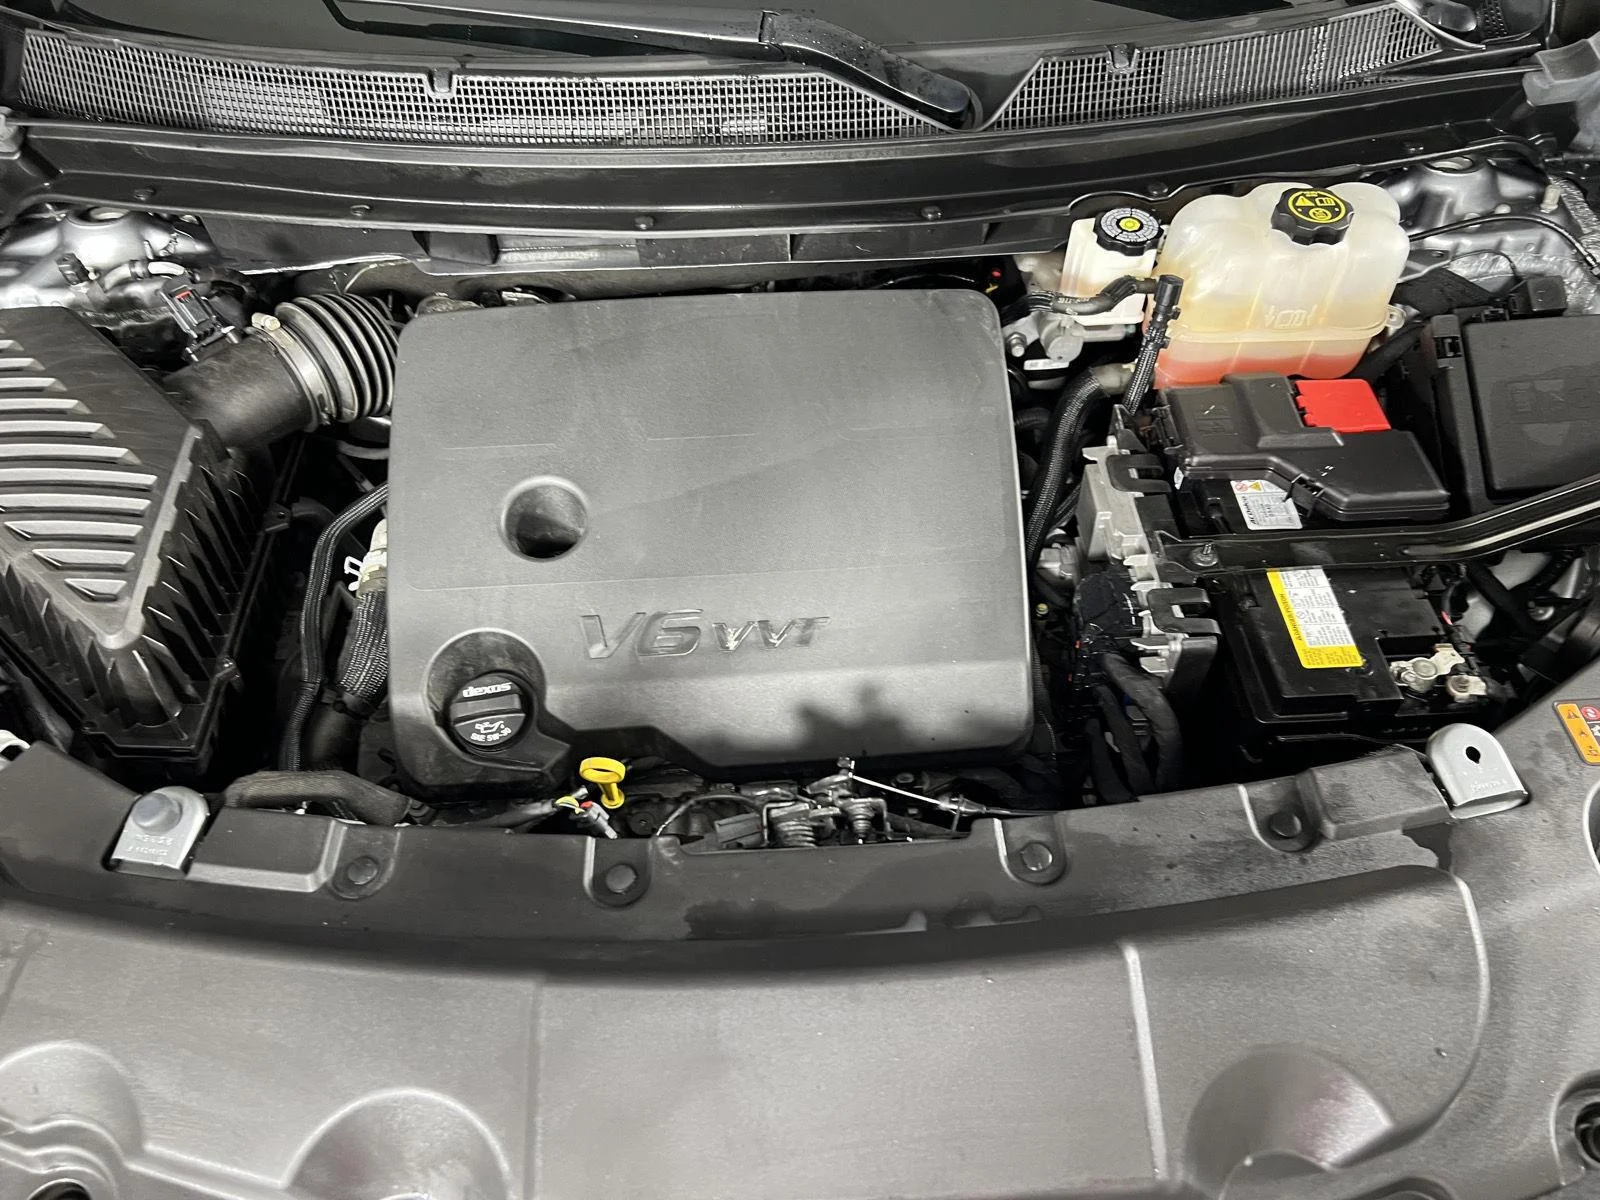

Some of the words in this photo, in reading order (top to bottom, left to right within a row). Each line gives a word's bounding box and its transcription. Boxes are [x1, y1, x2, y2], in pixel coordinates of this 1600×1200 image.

[580, 609, 703, 659] V6
[712, 616, 831, 651] VVT
[463, 682, 512, 697] dexos
[470, 733, 486, 741] SAE
[486, 727, 512, 741] 5W-30
